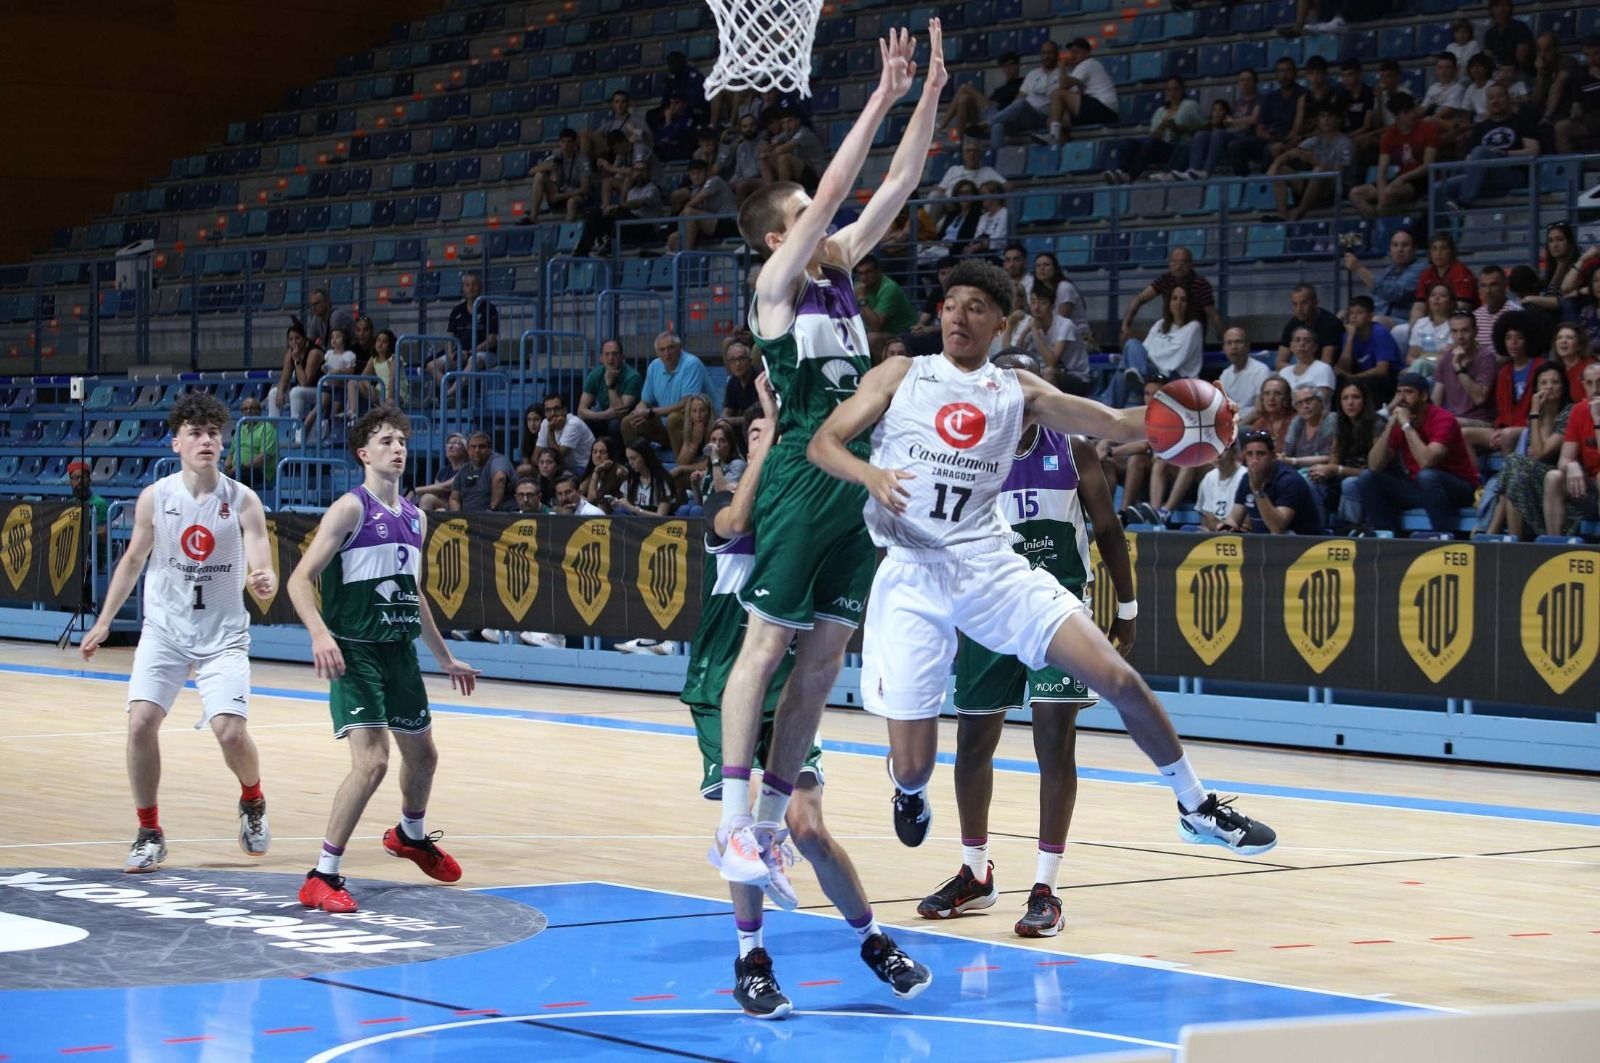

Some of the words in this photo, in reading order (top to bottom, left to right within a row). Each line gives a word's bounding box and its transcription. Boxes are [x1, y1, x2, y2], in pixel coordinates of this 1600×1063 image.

[909, 443, 999, 474] Casademont
[931, 467, 976, 482] ZARAGOZA
[929, 483, 973, 523] 17
[1013, 490, 1039, 519] 15
[518, 525, 533, 536] FEB
[397, 545, 409, 571] 9
[1216, 543, 1238, 556] FEB
[1328, 547, 1350, 560] FEB
[1444, 552, 1468, 566] FEB
[1569, 559, 1594, 574] FEB
[193, 585, 206, 610] 1
[1190, 563, 1229, 641] 100
[1298, 568, 1340, 649] 100
[1413, 574, 1459, 657] 100
[1537, 582, 1584, 668] 100
[1035, 683, 1064, 693] novo
